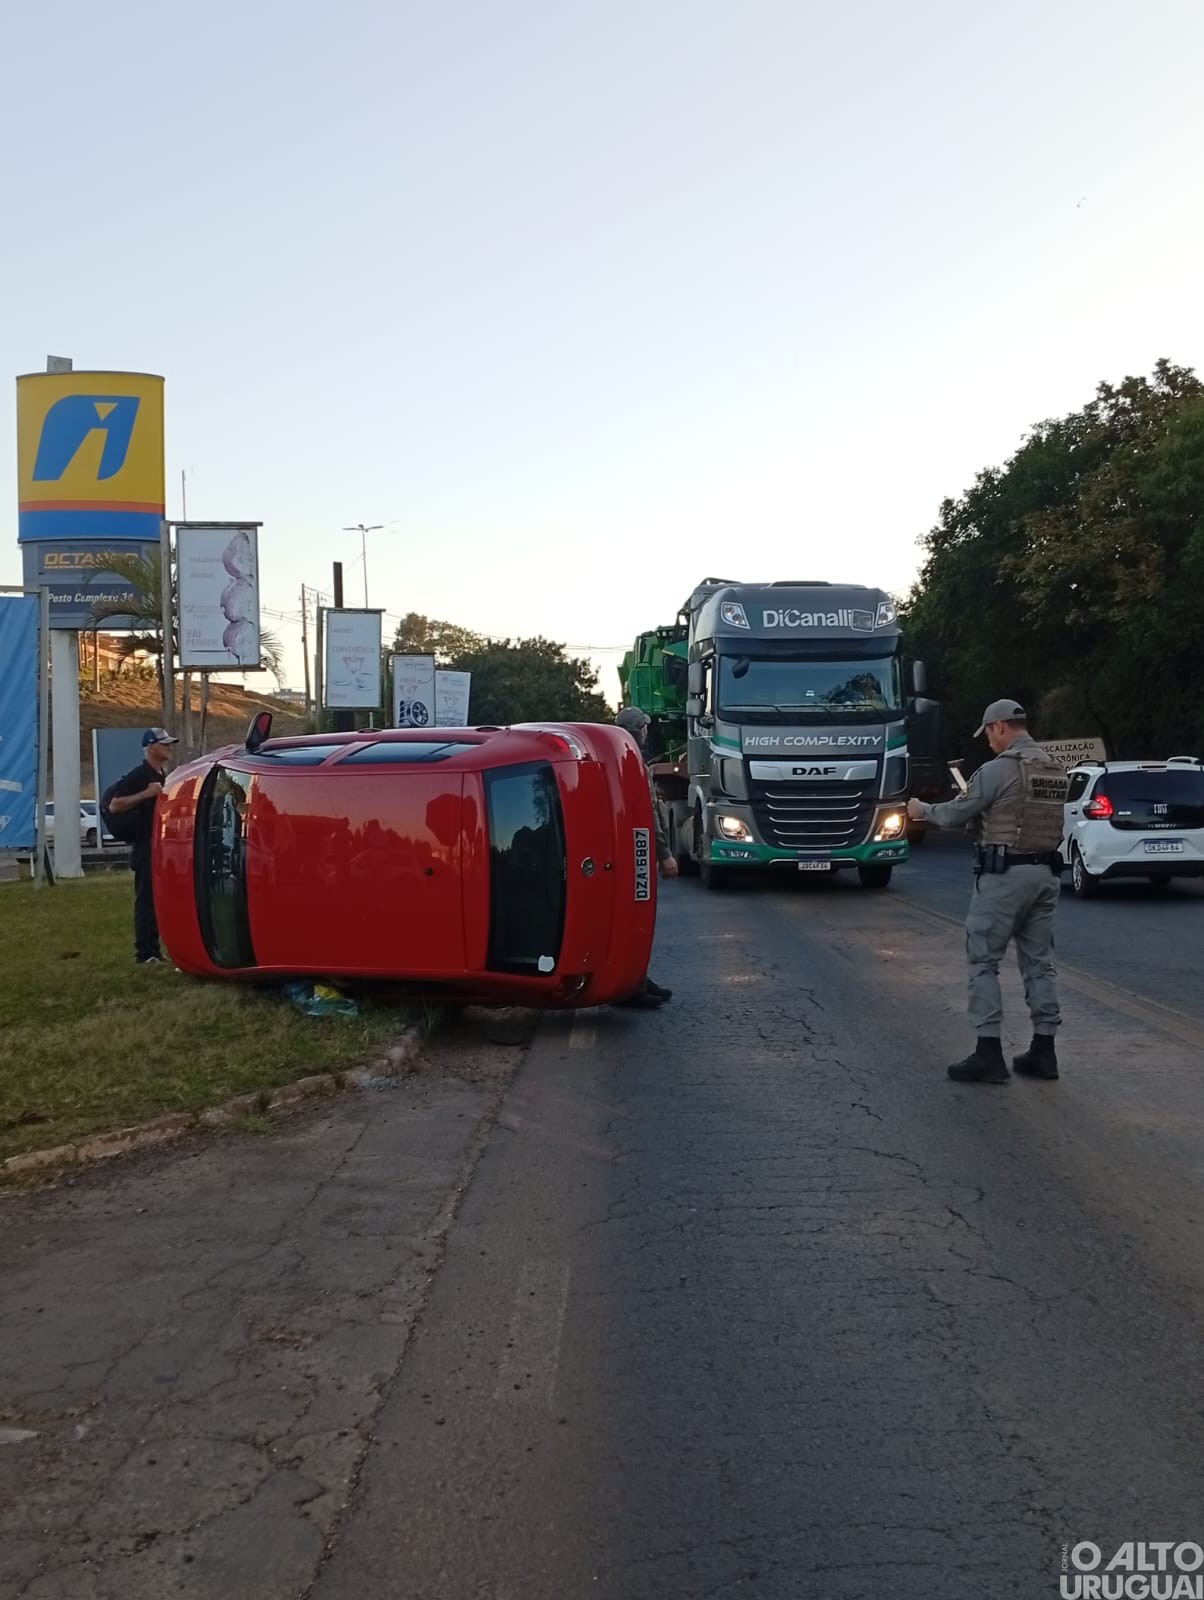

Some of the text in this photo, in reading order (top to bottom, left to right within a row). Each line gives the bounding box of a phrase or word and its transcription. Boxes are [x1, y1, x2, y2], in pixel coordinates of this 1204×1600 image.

[762, 607, 853, 629] DiCanalli
[744, 735, 882, 747] HIGH COMPLEXITY
[791, 766, 838, 776] DAF
[1032, 777, 1067, 790] BRIGADA
